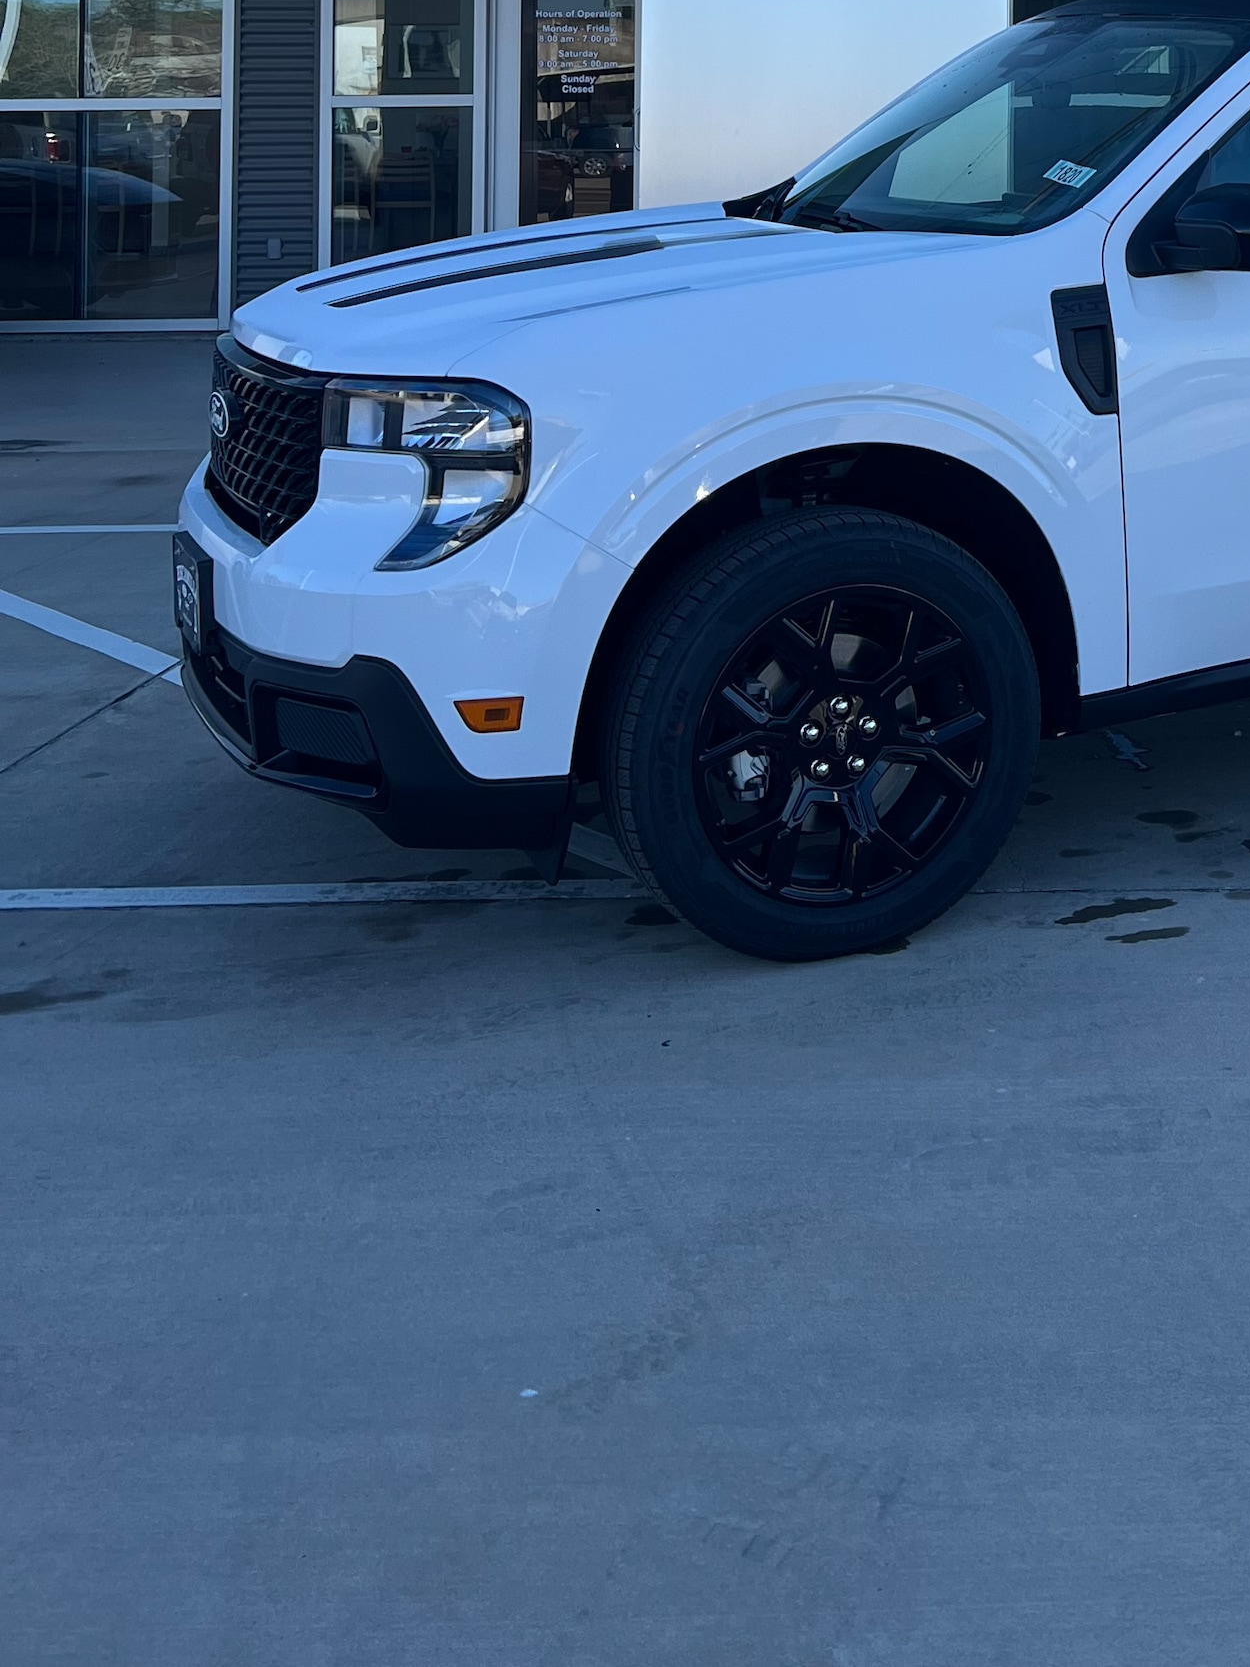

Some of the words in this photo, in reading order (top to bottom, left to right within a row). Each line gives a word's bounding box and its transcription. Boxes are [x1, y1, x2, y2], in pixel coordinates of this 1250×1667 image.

[535, 10, 563, 18] Hours
[565, 10, 575, 18] of
[577, 10, 622, 19] Operation
[542, 24, 578, 34] Monday
[586, 24, 615, 34] Friday
[603, 36, 618, 44] pm
[558, 49, 599, 59] Saturday
[538, 60, 557, 68] 9:00
[582, 60, 602, 68] 5:00
[603, 61, 618, 69] pm
[560, 74, 597, 85] Sunday
[562, 85, 594, 93] Closed
[1053, 165, 1082, 183] 1820
